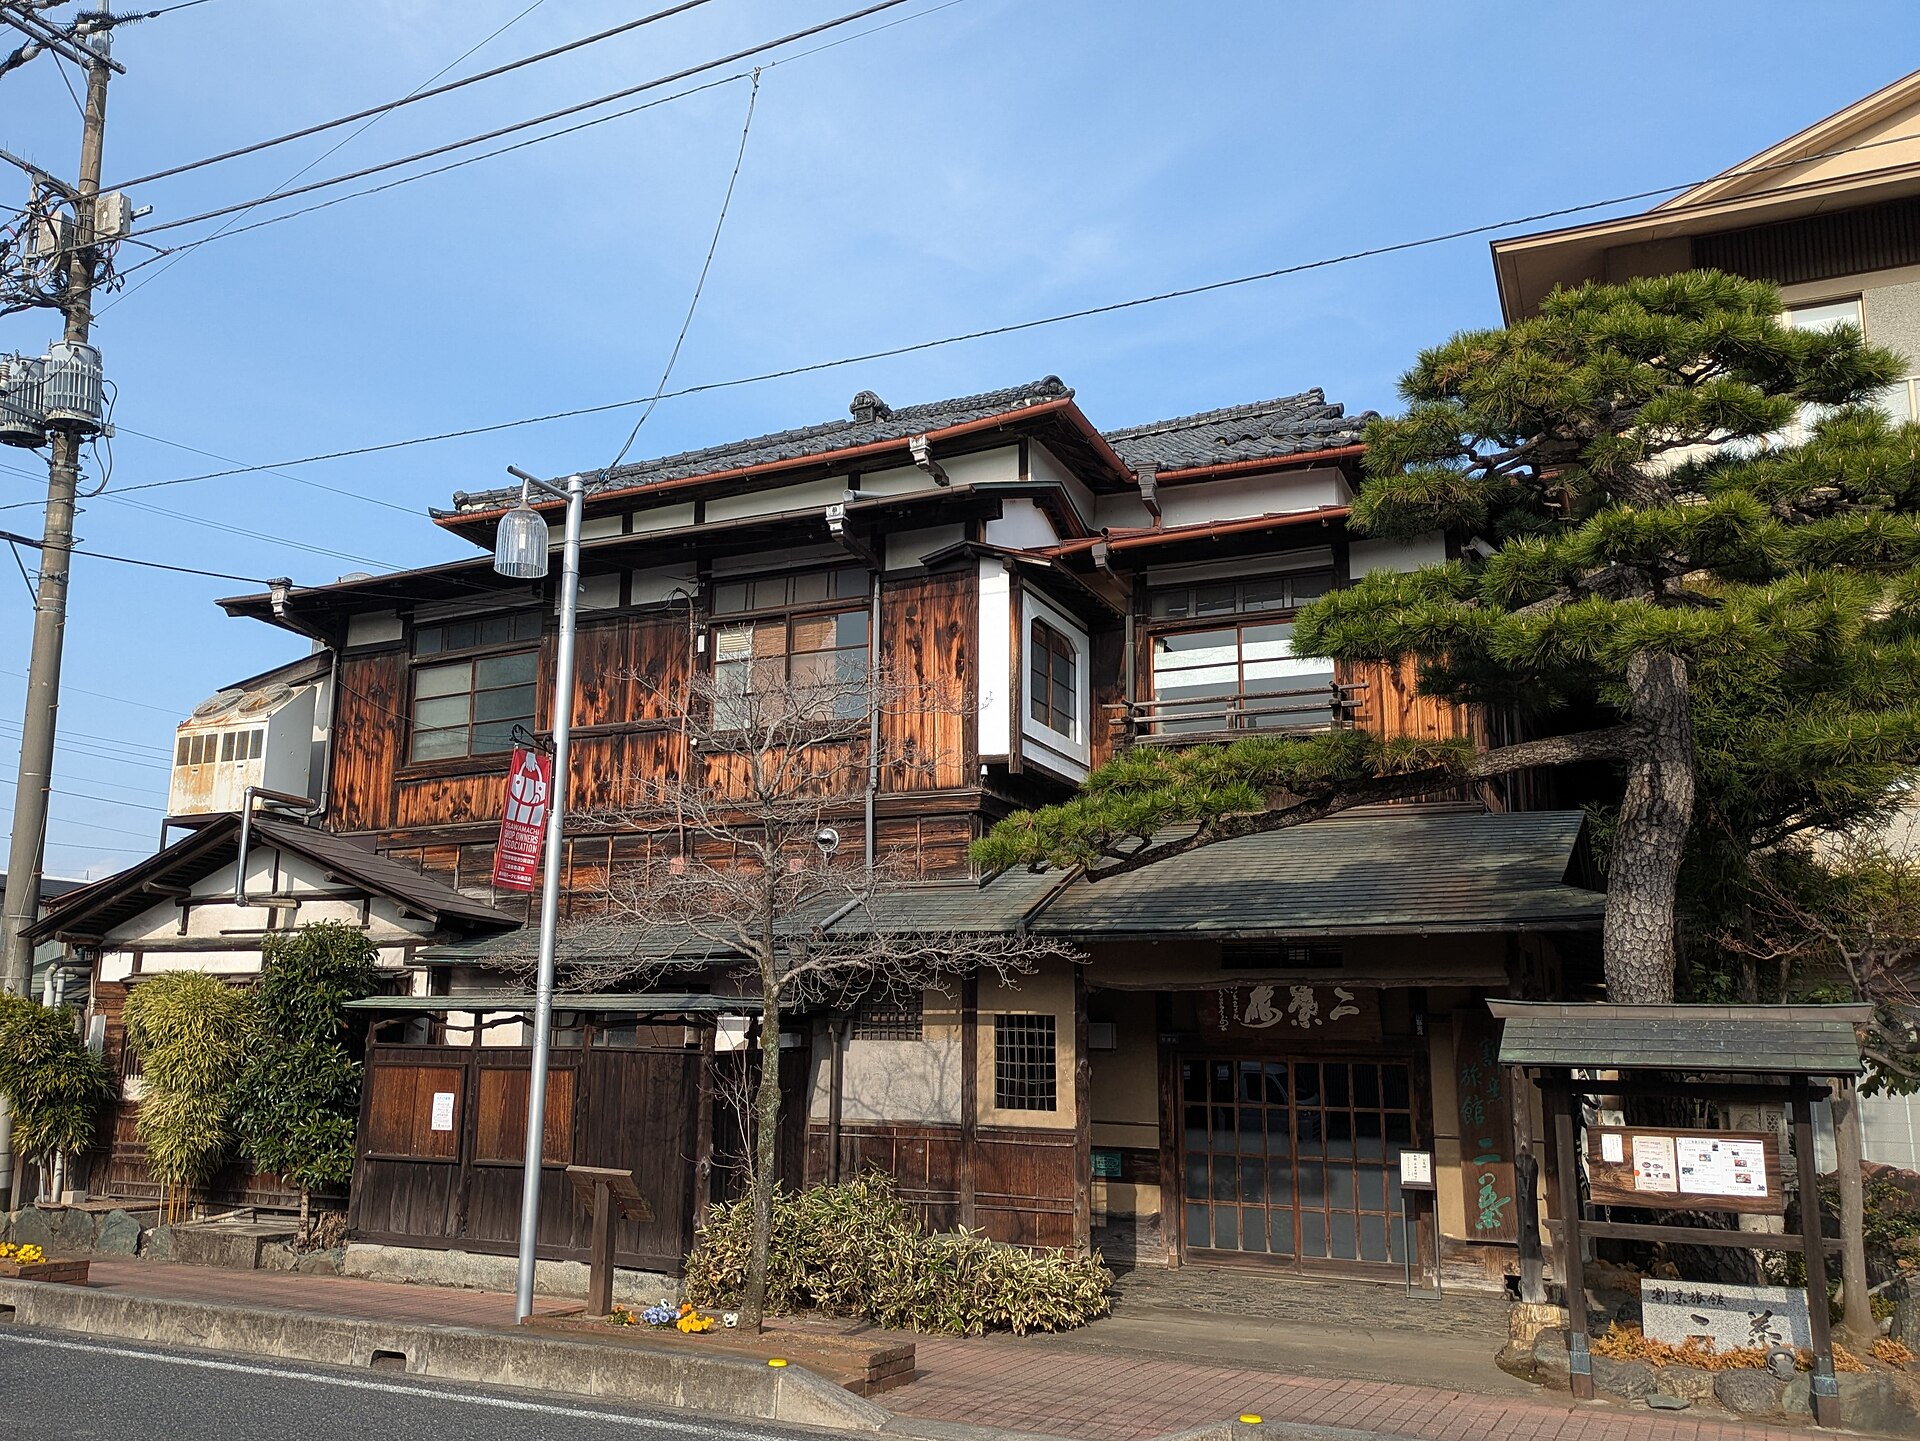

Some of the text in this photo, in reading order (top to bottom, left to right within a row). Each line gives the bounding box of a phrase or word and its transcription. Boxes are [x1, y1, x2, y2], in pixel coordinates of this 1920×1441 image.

[505, 822, 540, 835] OGAWAMACHI
[504, 830, 539, 845] SHOP OWNERS
[503, 840, 537, 853] ASSOCIATION
[1460, 1062, 1486, 1126] 旅館
[1651, 1287, 1727, 1307] 割烹旅館
